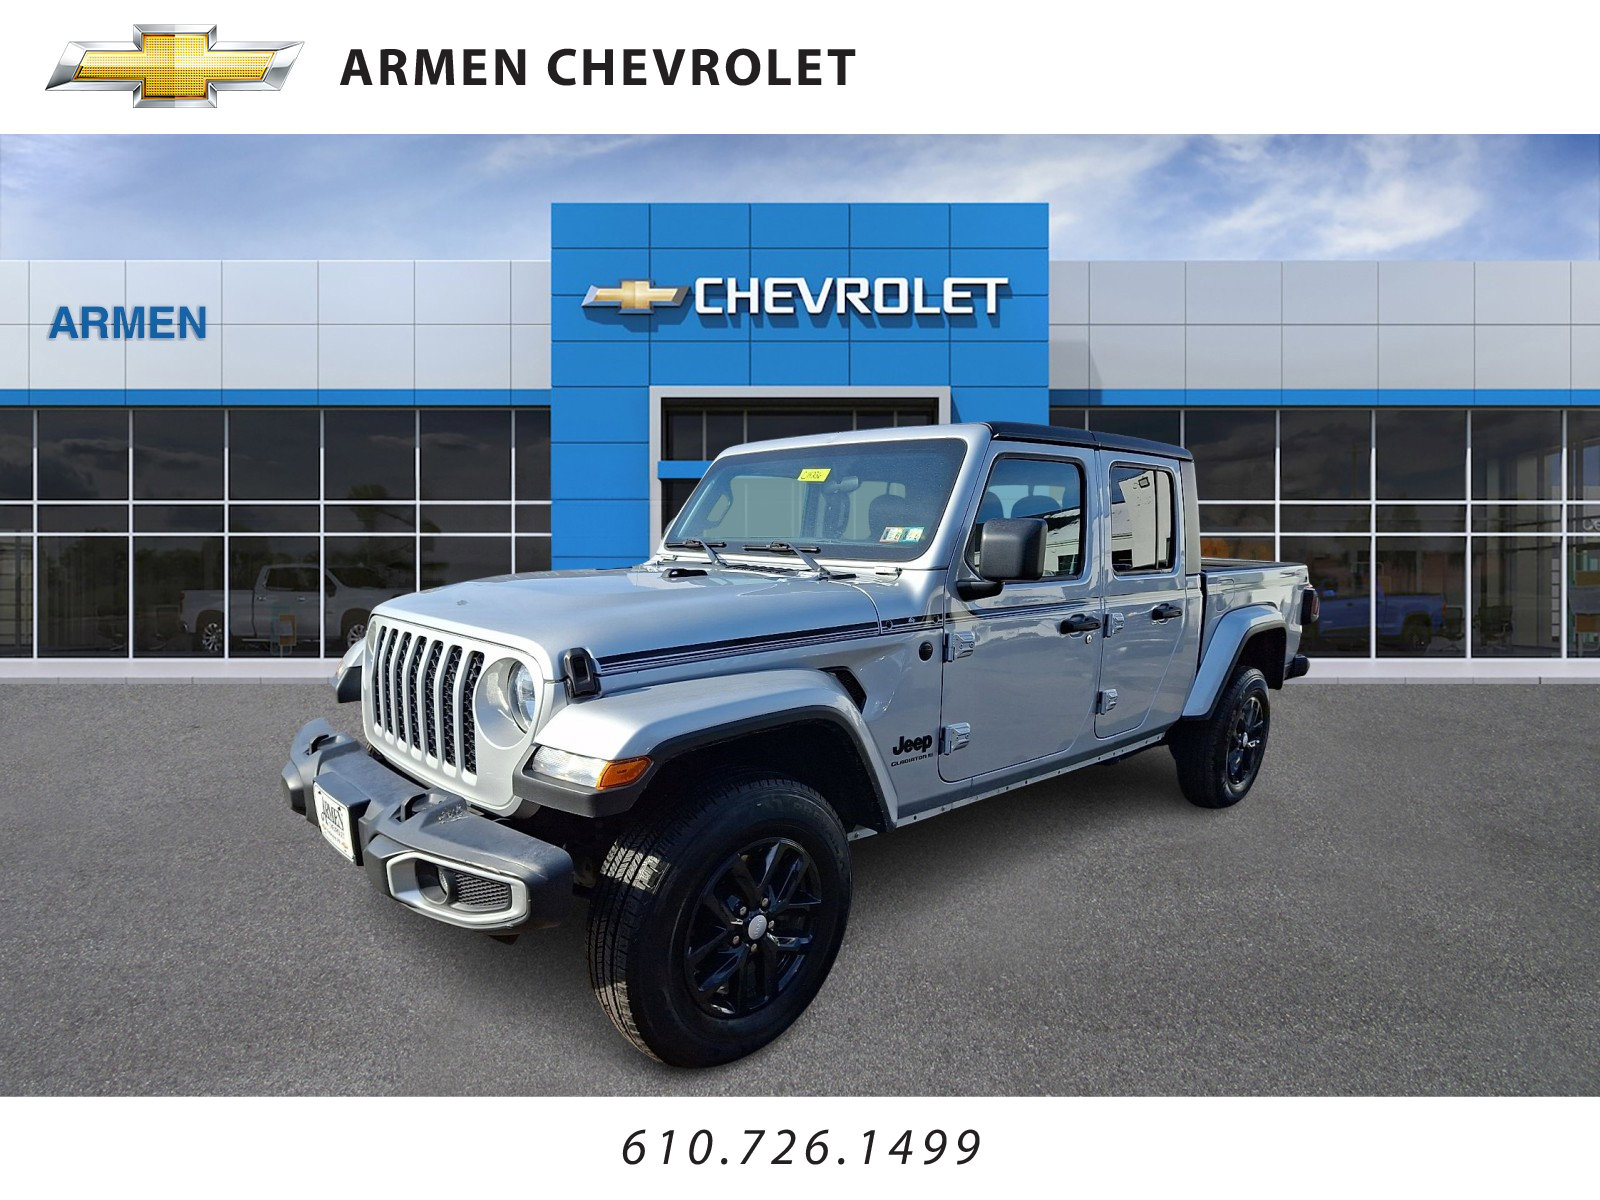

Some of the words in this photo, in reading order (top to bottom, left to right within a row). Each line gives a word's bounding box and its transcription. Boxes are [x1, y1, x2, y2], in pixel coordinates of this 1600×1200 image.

[694, 277, 1009, 316] CHEVROLET
[48, 305, 207, 340] ARMEN
[892, 734, 933, 756] Jeep
